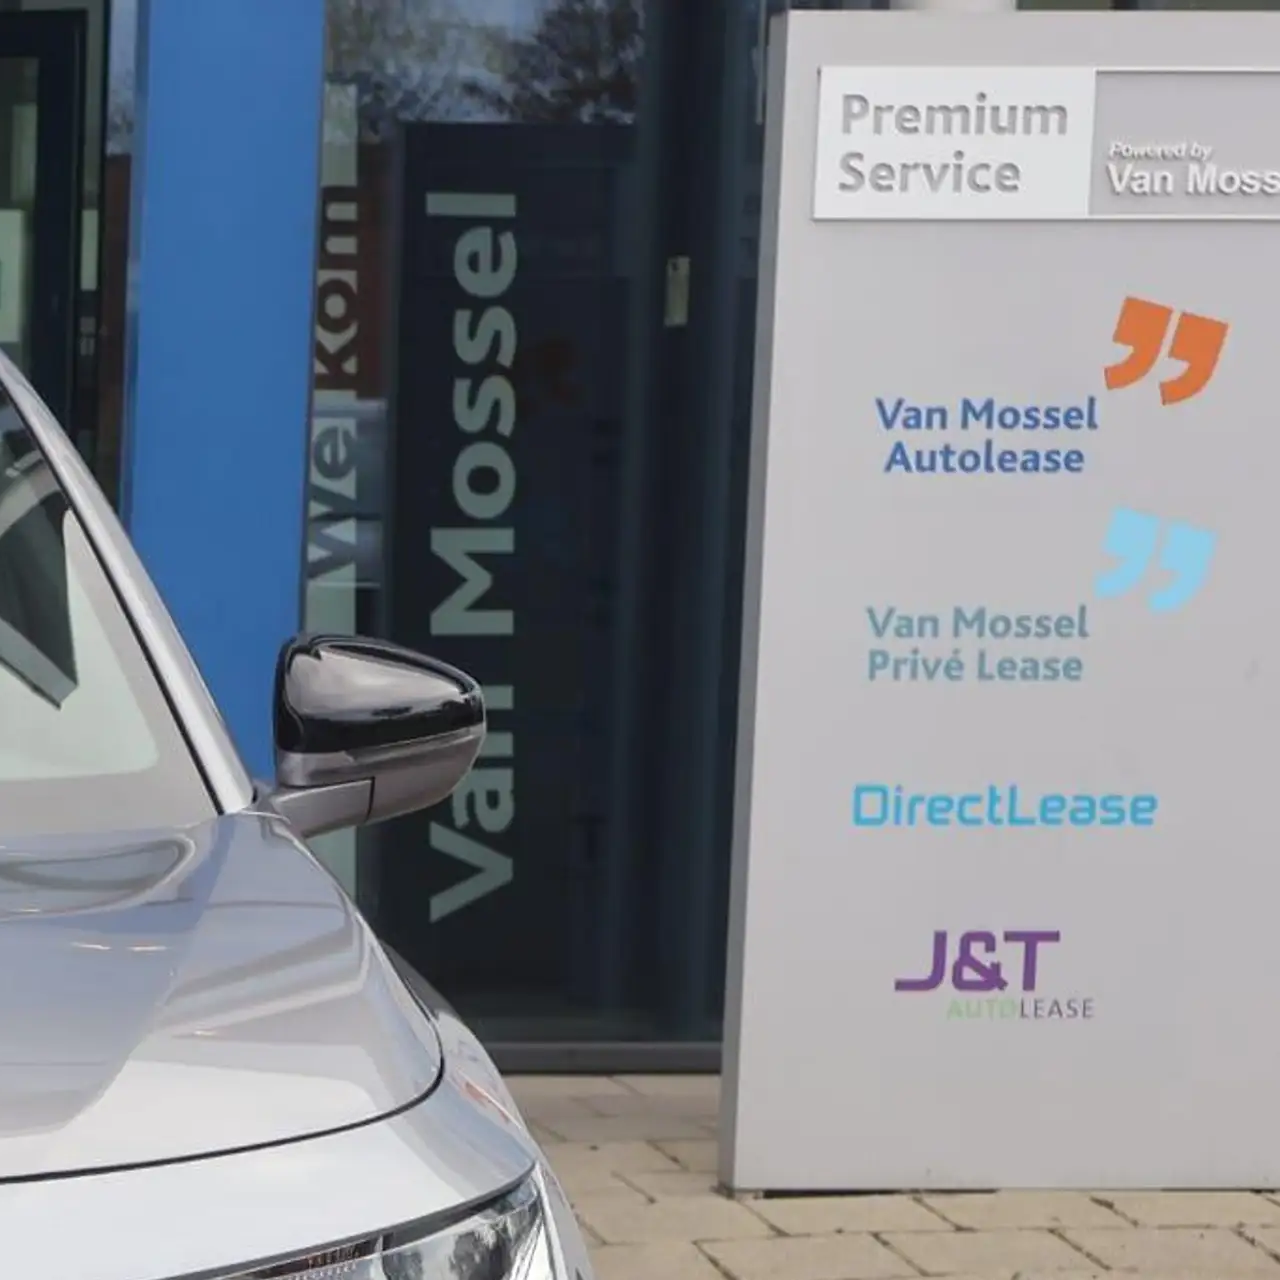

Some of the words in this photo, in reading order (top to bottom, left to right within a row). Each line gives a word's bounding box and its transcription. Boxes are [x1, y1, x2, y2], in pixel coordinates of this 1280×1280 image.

[842, 92, 1068, 136] Premium
[1108, 140, 1188, 159] Powered
[1190, 141, 1213, 161] by
[838, 149, 1021, 194] Service
[1107, 162, 1174, 194] Van
[1187, 162, 1280, 194] Moss
[425, 193, 518, 636] Mossel
[874, 397, 949, 432] Van
[960, 395, 1099, 431] Mossel
[883, 437, 1085, 474] Autolease
[866, 607, 940, 639] Van
[952, 604, 1090, 639] Mossel
[868, 647, 965, 682] Privé
[977, 650, 1083, 681] Lease
[853, 784, 1158, 826] DirectLease
[893, 929, 1062, 993] J&T
[947, 997, 1096, 1020] AUTOLEASE
